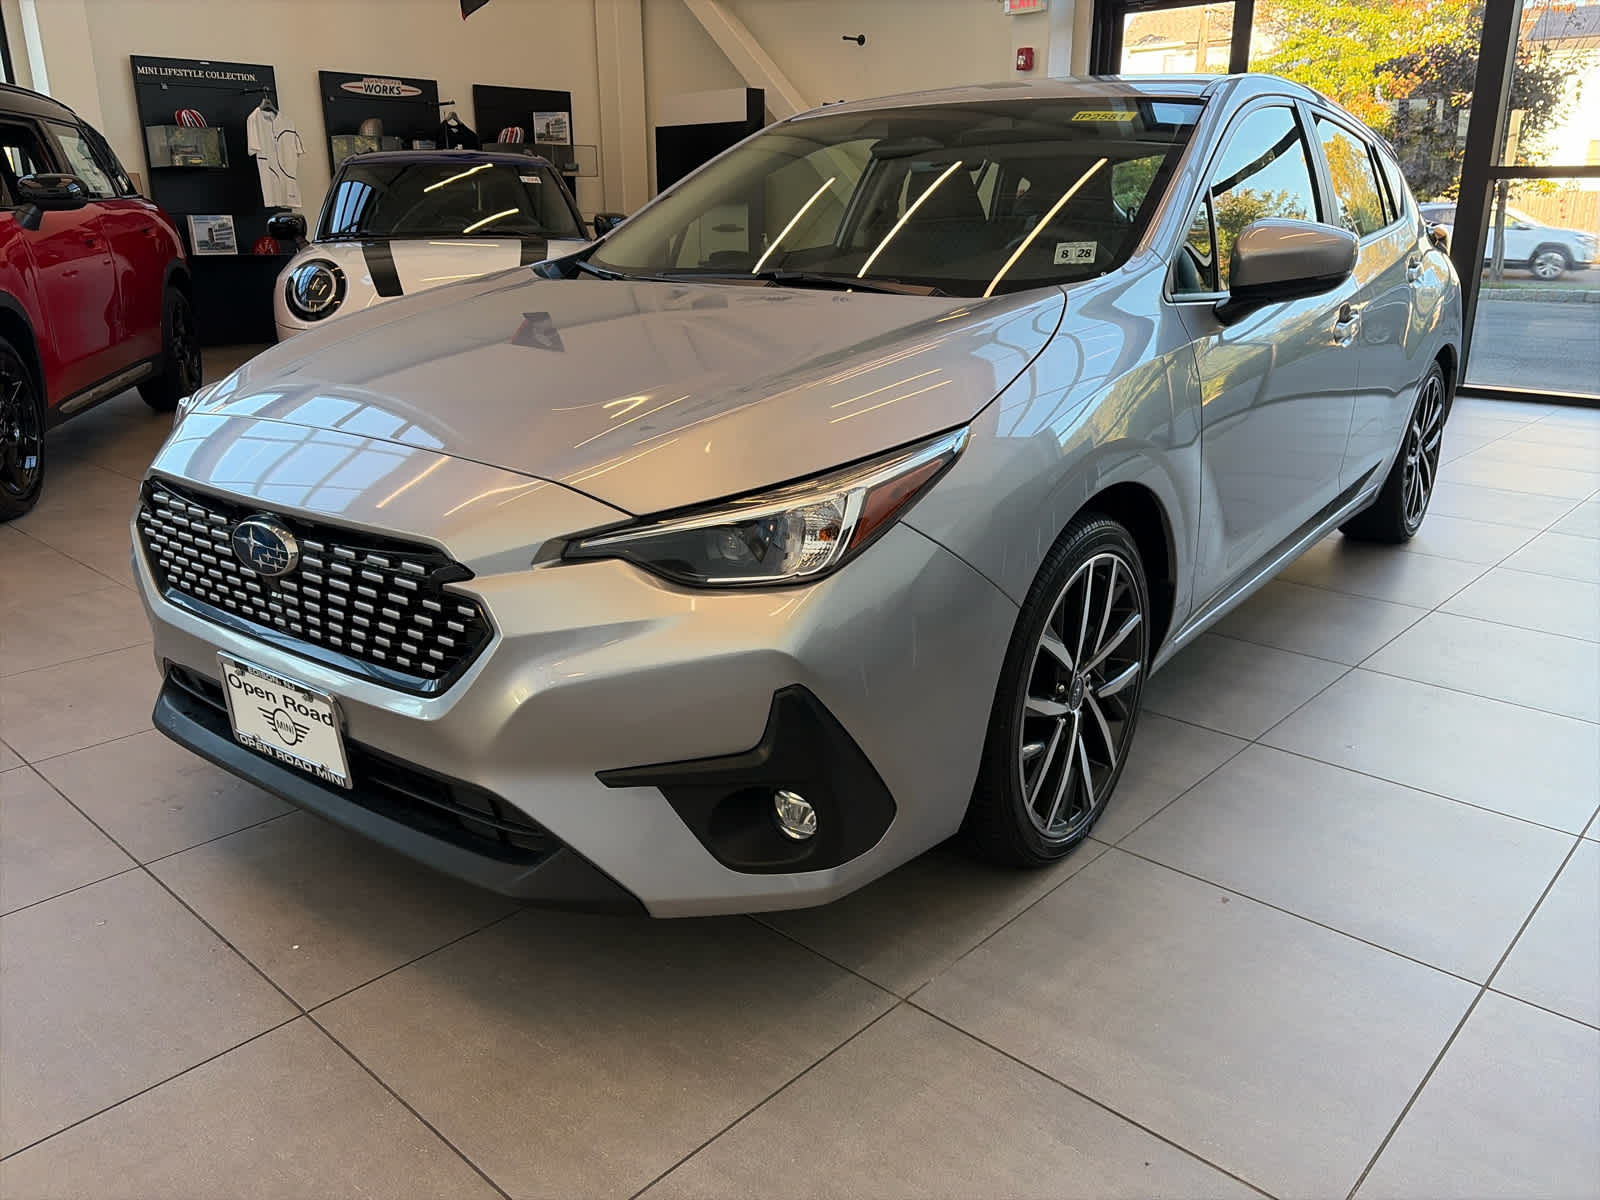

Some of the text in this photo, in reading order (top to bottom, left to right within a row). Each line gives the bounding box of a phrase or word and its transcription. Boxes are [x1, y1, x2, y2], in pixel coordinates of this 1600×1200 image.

[136, 65, 158, 76] MINI
[159, 67, 205, 79] LIFESTYLE
[363, 84, 402, 96] WORKS
[1060, 248, 1092, 259] 8 28
[228, 673, 335, 728] Open Road
[275, 719, 295, 735] MINI
[239, 733, 345, 788] OPEN ROAD MINI
